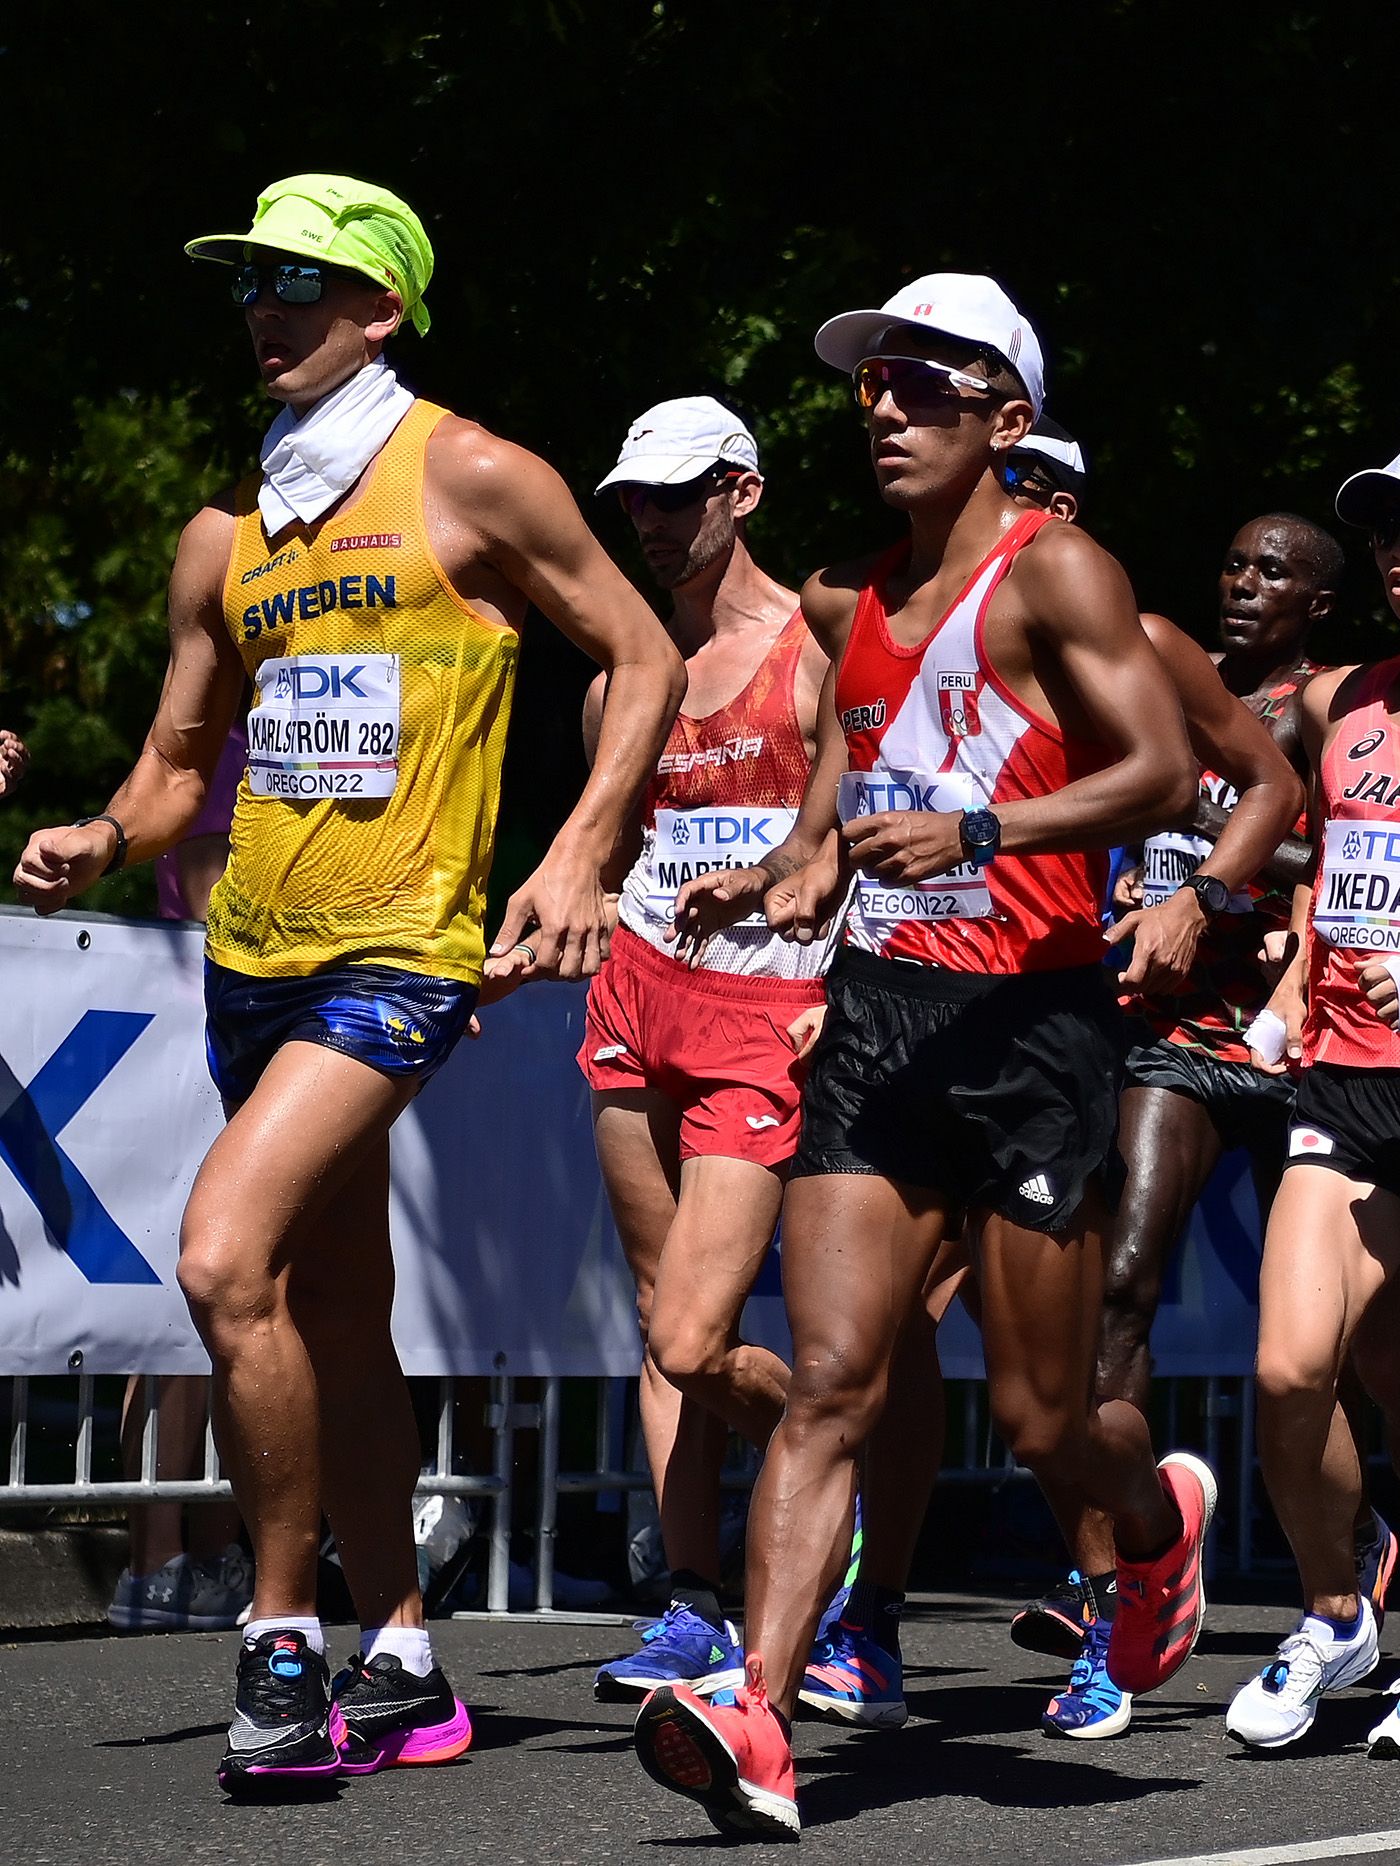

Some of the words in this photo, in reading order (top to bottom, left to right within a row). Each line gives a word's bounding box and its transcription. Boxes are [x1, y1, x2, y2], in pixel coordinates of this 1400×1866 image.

[301, 229, 323, 243] SWE
[331, 535, 400, 551] BAUHAUS
[241, 553, 286, 584] CRAFT
[243, 575, 396, 641] SWEDEN
[290, 665, 368, 698] TDK
[940, 676, 971, 688] PERU
[842, 699, 885, 735] PERÚ
[251, 712, 349, 754] KARLSTRÖM
[358, 723, 394, 755] 282
[266, 774, 363, 793] OREGON22
[864, 784, 938, 812] TDK
[690, 817, 773, 845] TDK
[861, 893, 960, 915] REGON22
[1019, 1186, 1054, 1205] adidas
